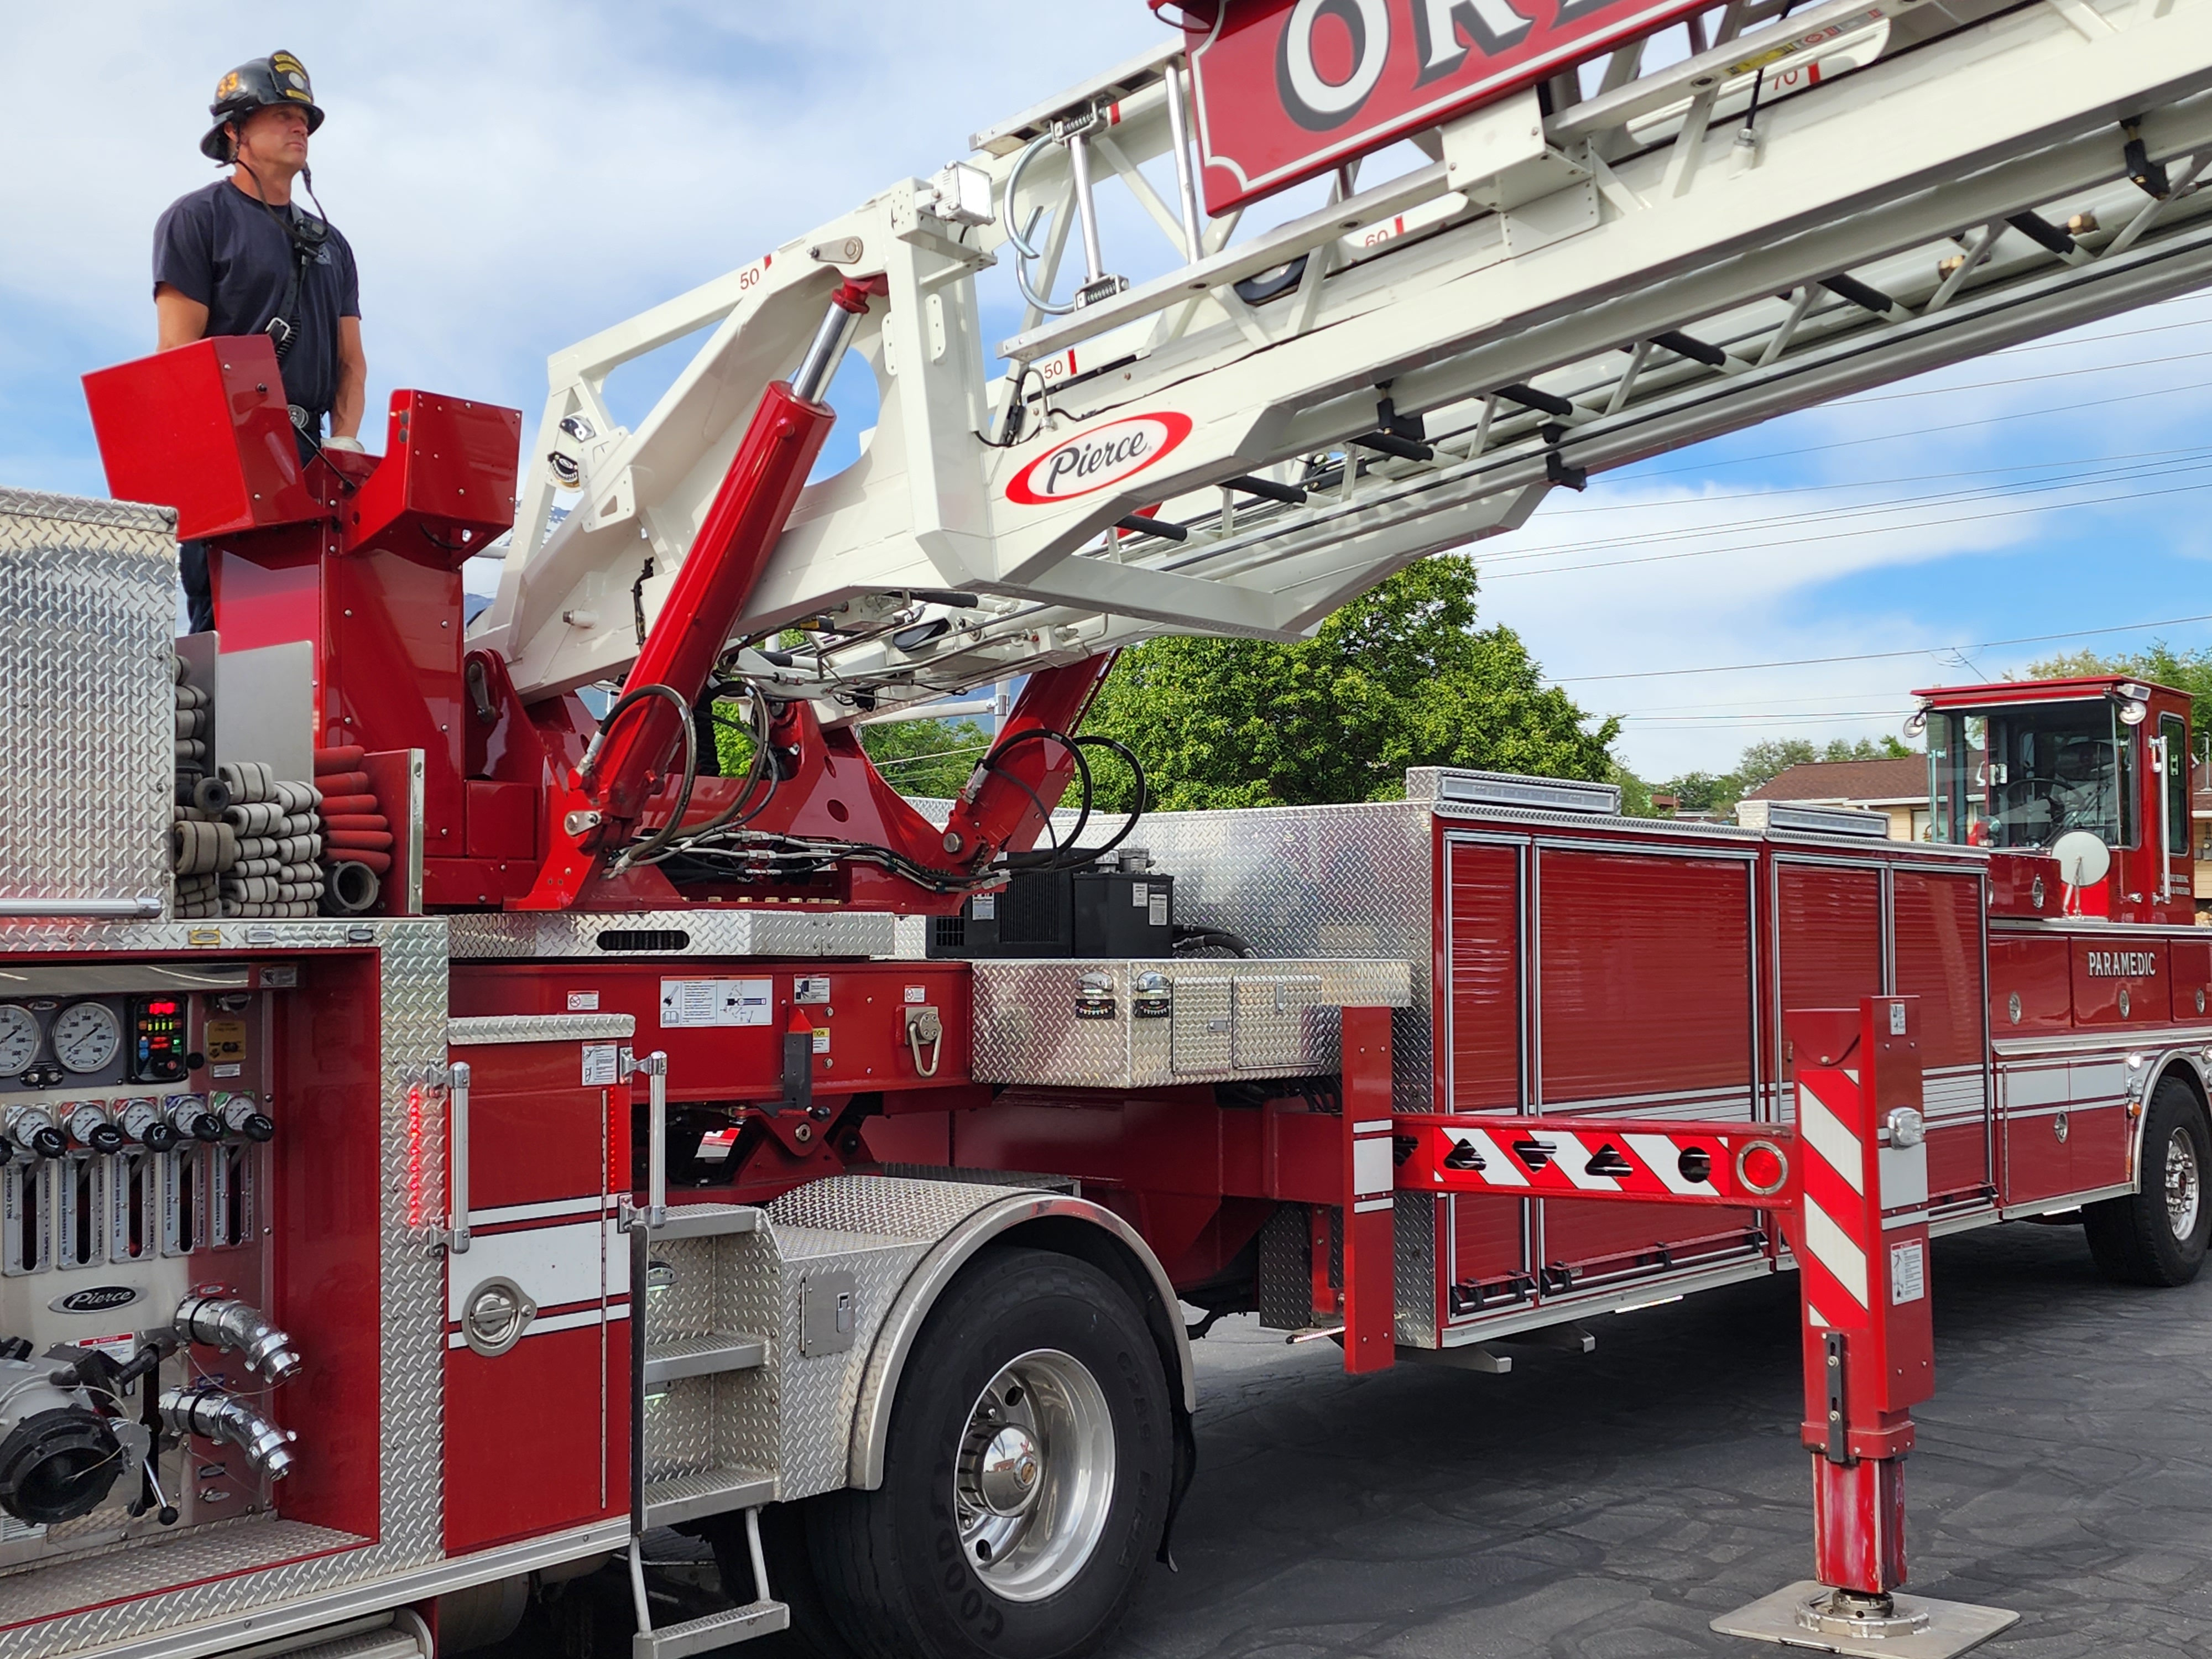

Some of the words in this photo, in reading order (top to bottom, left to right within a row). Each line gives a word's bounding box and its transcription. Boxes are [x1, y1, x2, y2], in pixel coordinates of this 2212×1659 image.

[740, 267, 760, 290] 50
[1044, 360, 1063, 379] 50
[1046, 431, 1148, 494] Pierce
[2088, 951, 2156, 977] PARAMEDIC
[68, 1290, 132, 1308] Pierce
